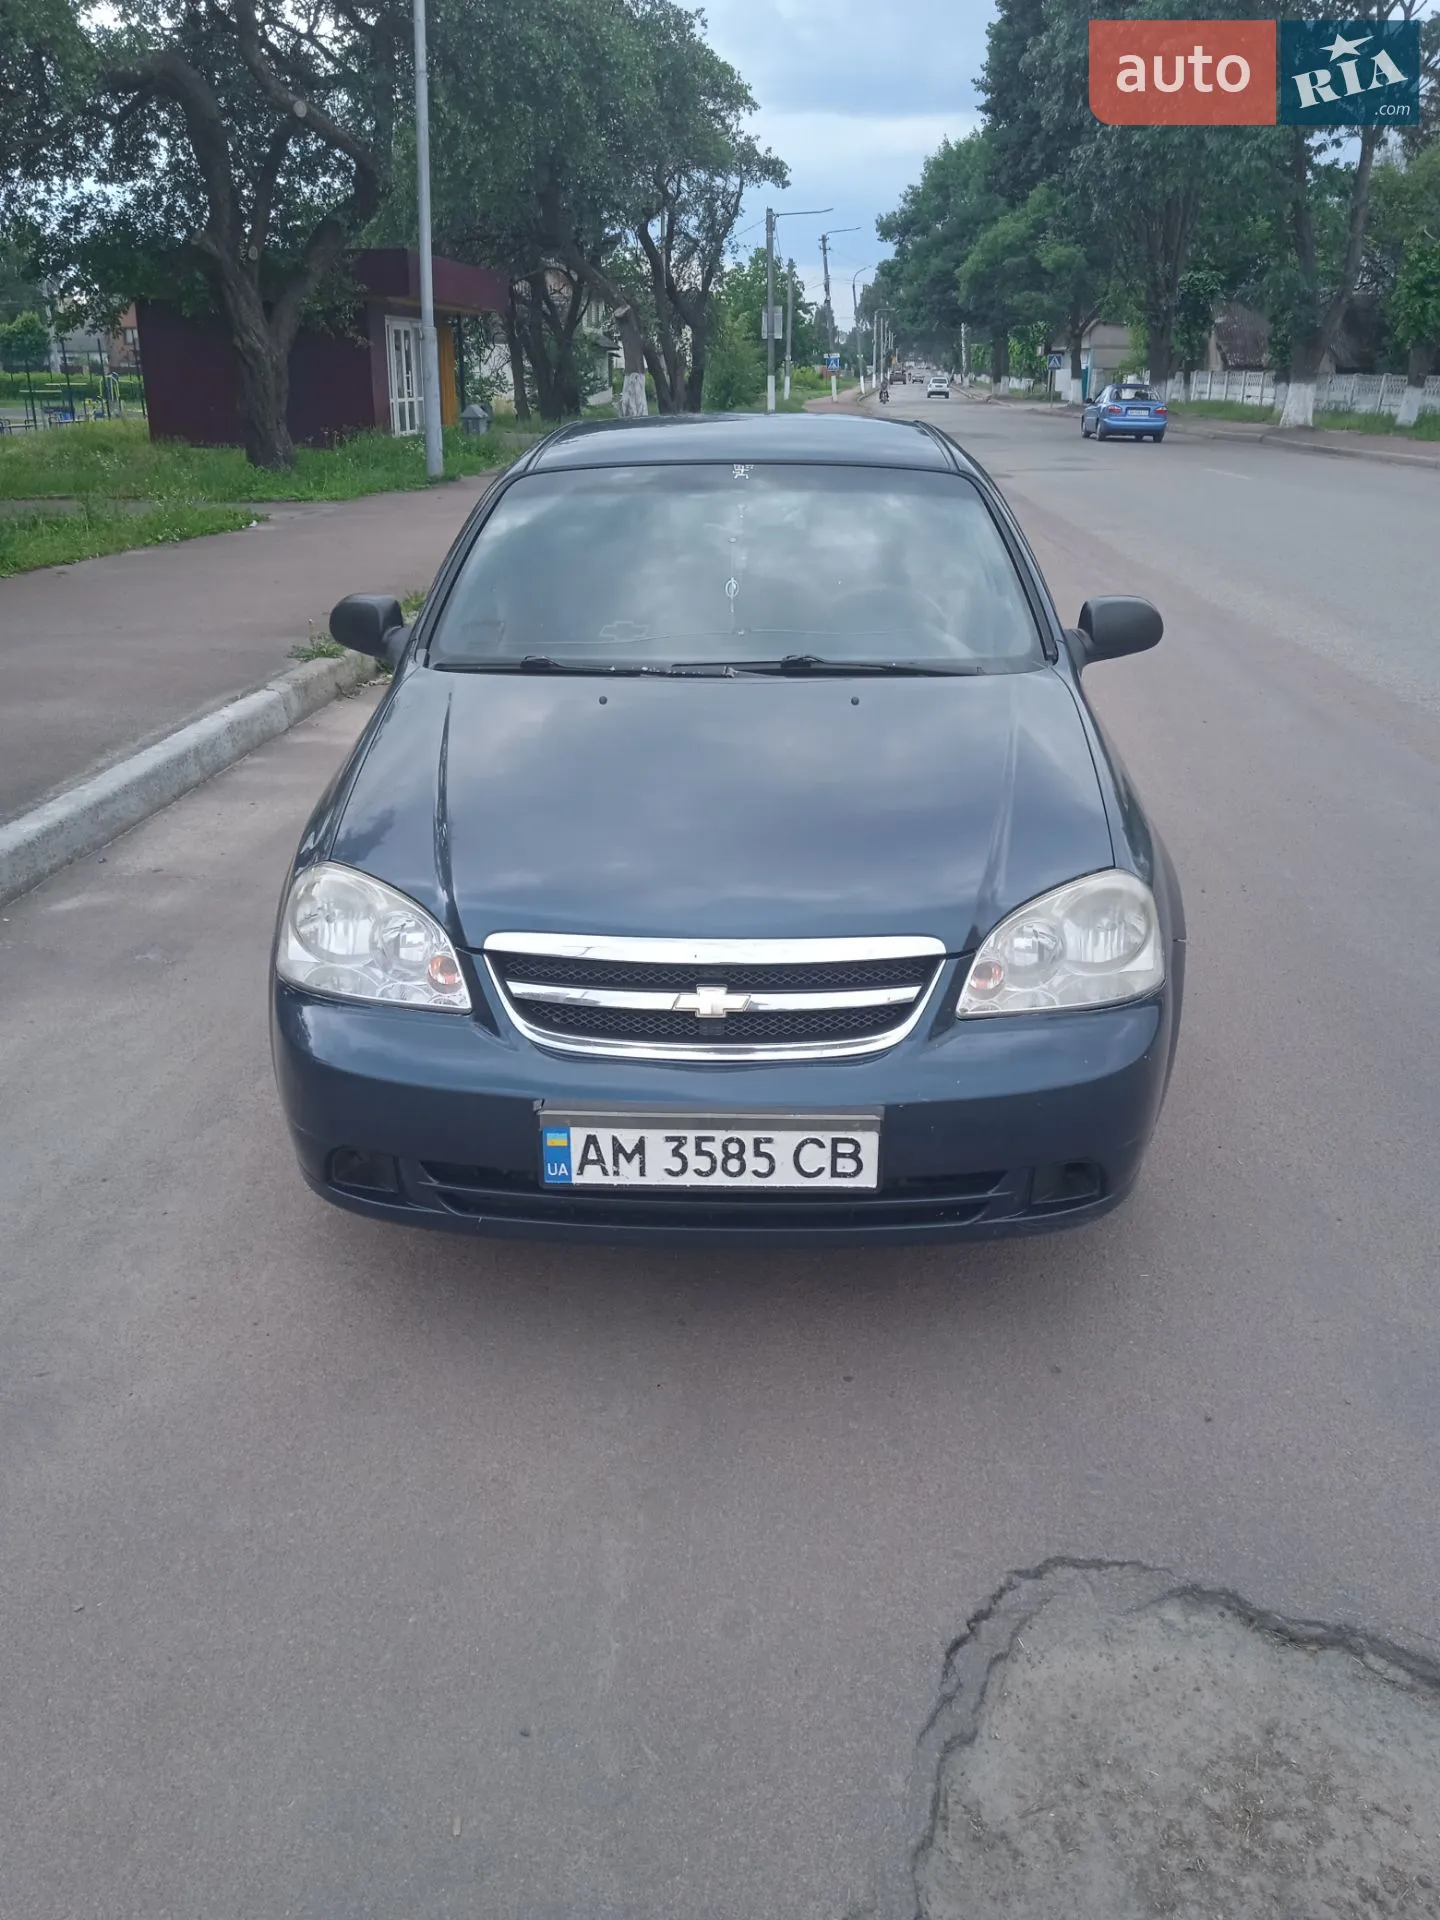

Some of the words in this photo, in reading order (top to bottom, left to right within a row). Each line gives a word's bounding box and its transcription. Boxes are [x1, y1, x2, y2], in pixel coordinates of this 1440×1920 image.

[547, 1163, 568, 1176] UA
[576, 1133, 647, 1177] AM
[664, 1135, 776, 1179] 3585
[792, 1136, 864, 1179] CB
